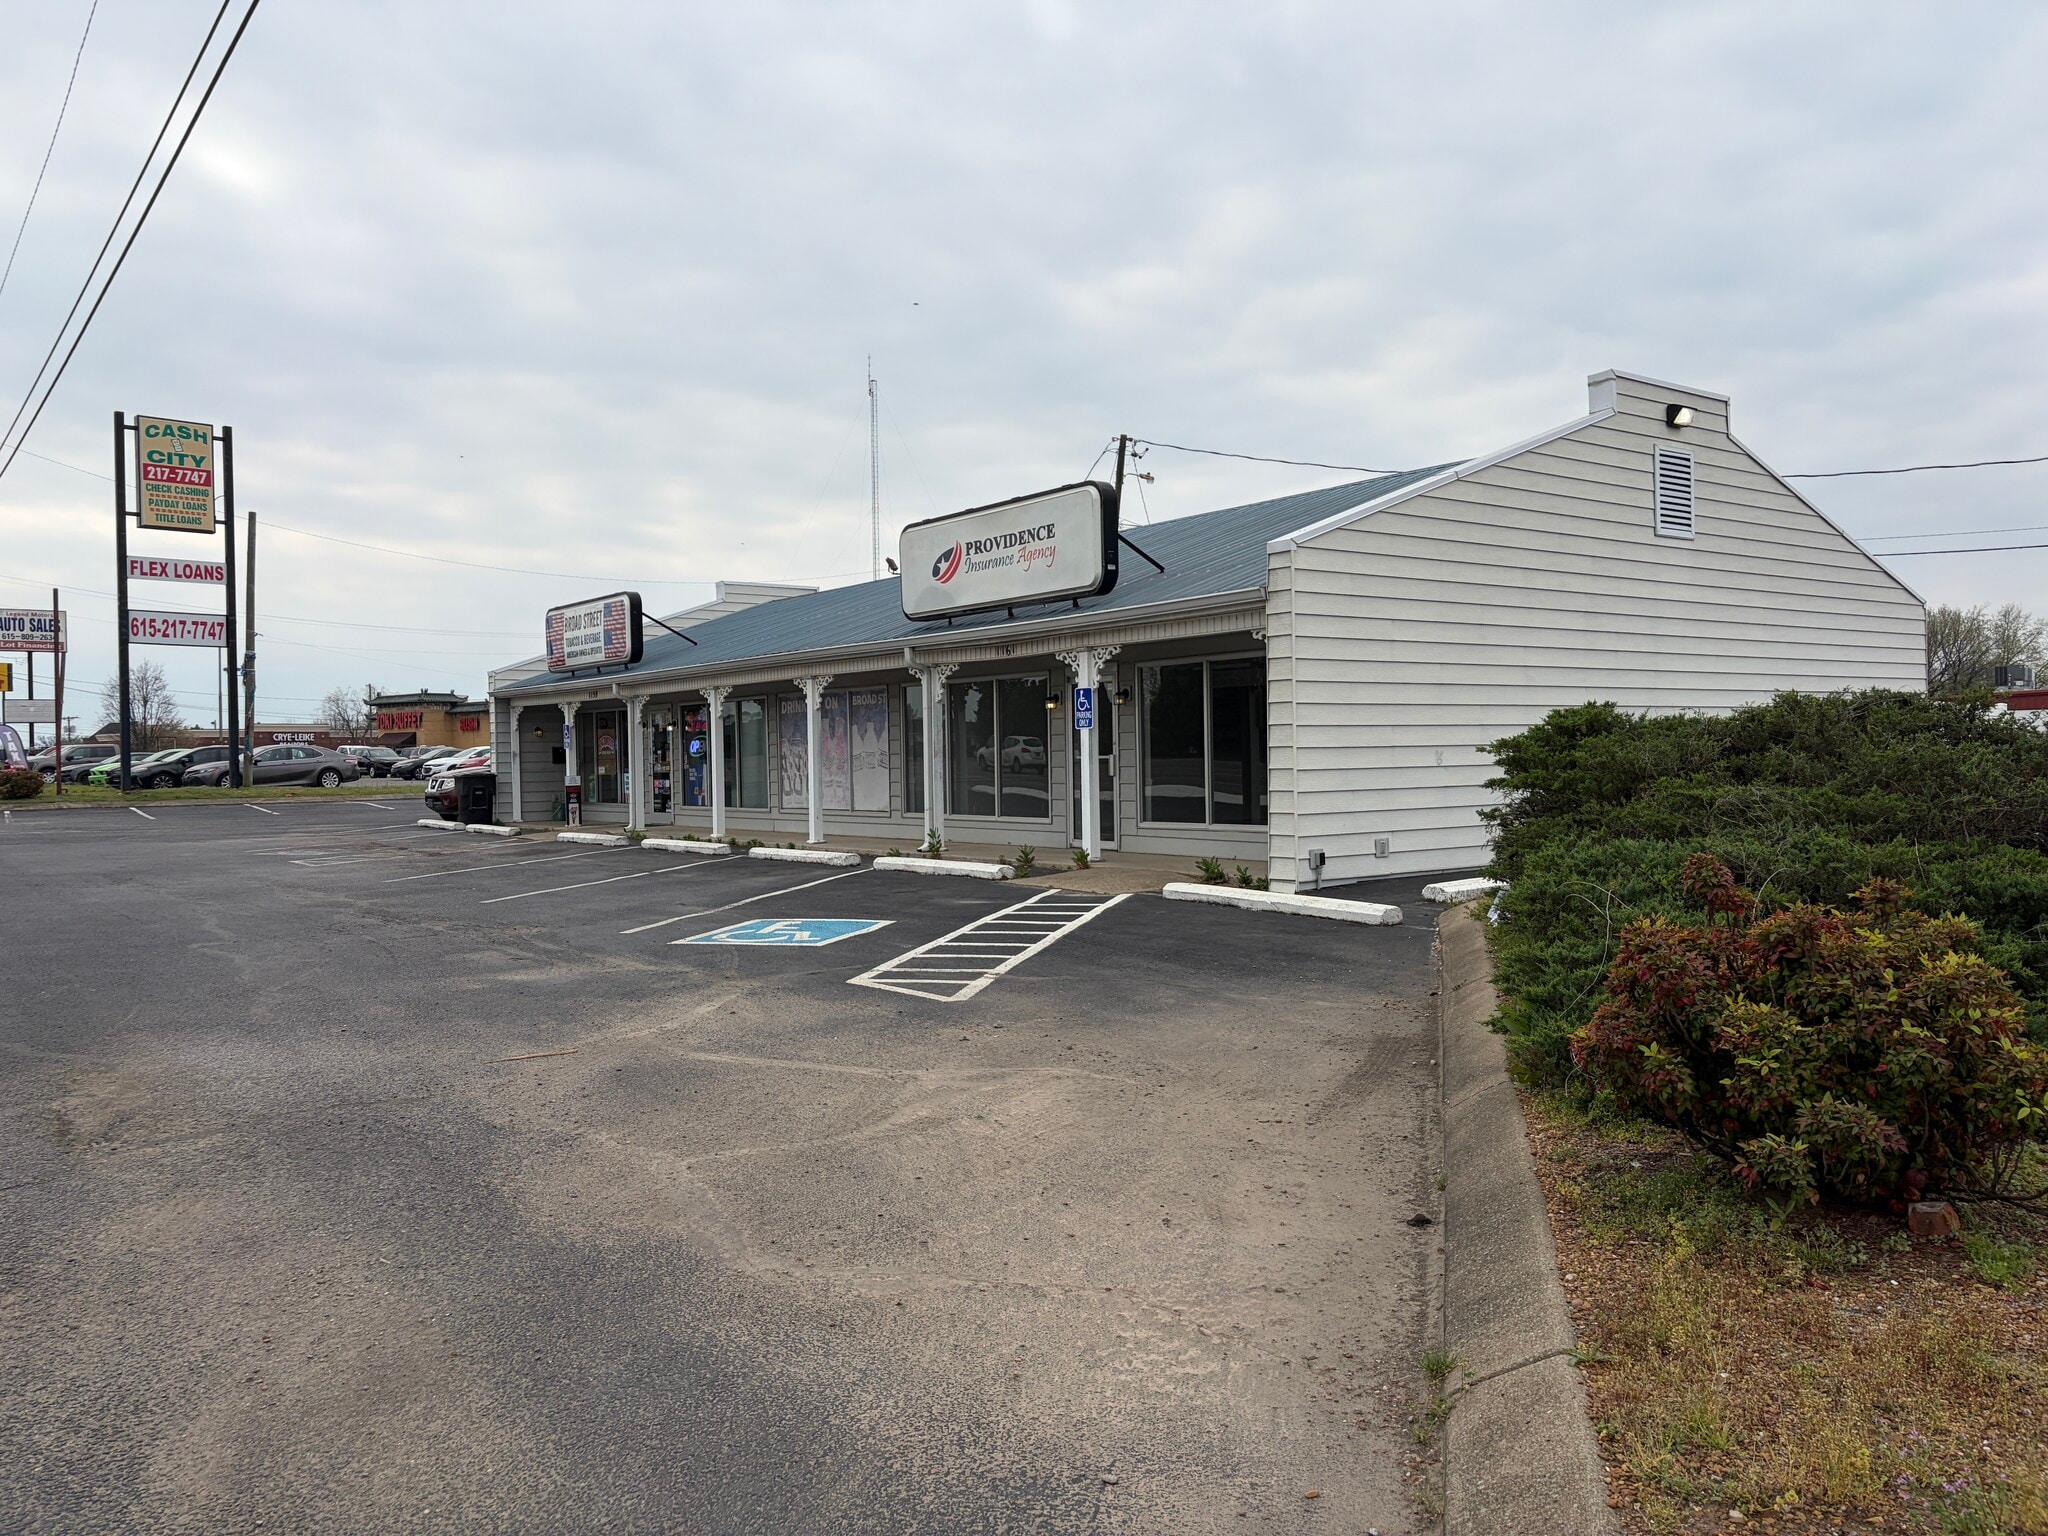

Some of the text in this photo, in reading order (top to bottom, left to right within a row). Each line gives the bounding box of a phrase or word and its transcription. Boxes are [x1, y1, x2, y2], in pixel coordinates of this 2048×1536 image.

[145, 424, 208, 445] CASH
[146, 450, 207, 468] CITY
[147, 466, 207, 484] 217-7747
[145, 483, 209, 497] CHECK CASHING
[149, 498, 208, 511] PAYDAY LOANS
[155, 513, 202, 525] TITLE LOANS
[965, 523, 1056, 556] PROVIDENCE
[964, 545, 1056, 574] Insurance Agency
[130, 559, 224, 581] FLEX LOANS
[131, 617, 225, 640] 615-217-7747
[565, 609, 602, 632] BROAD STREET
[2, 633, 55, 641] 615-809-263
[781, 693, 887, 714] DRINK ON BROAD ST
[394, 711, 422, 729] BUFFET
[1076, 711, 1092, 719] PARKING
[3, 731, 21, 762] TAX
[272, 733, 315, 742] CRYE-LEIKE
